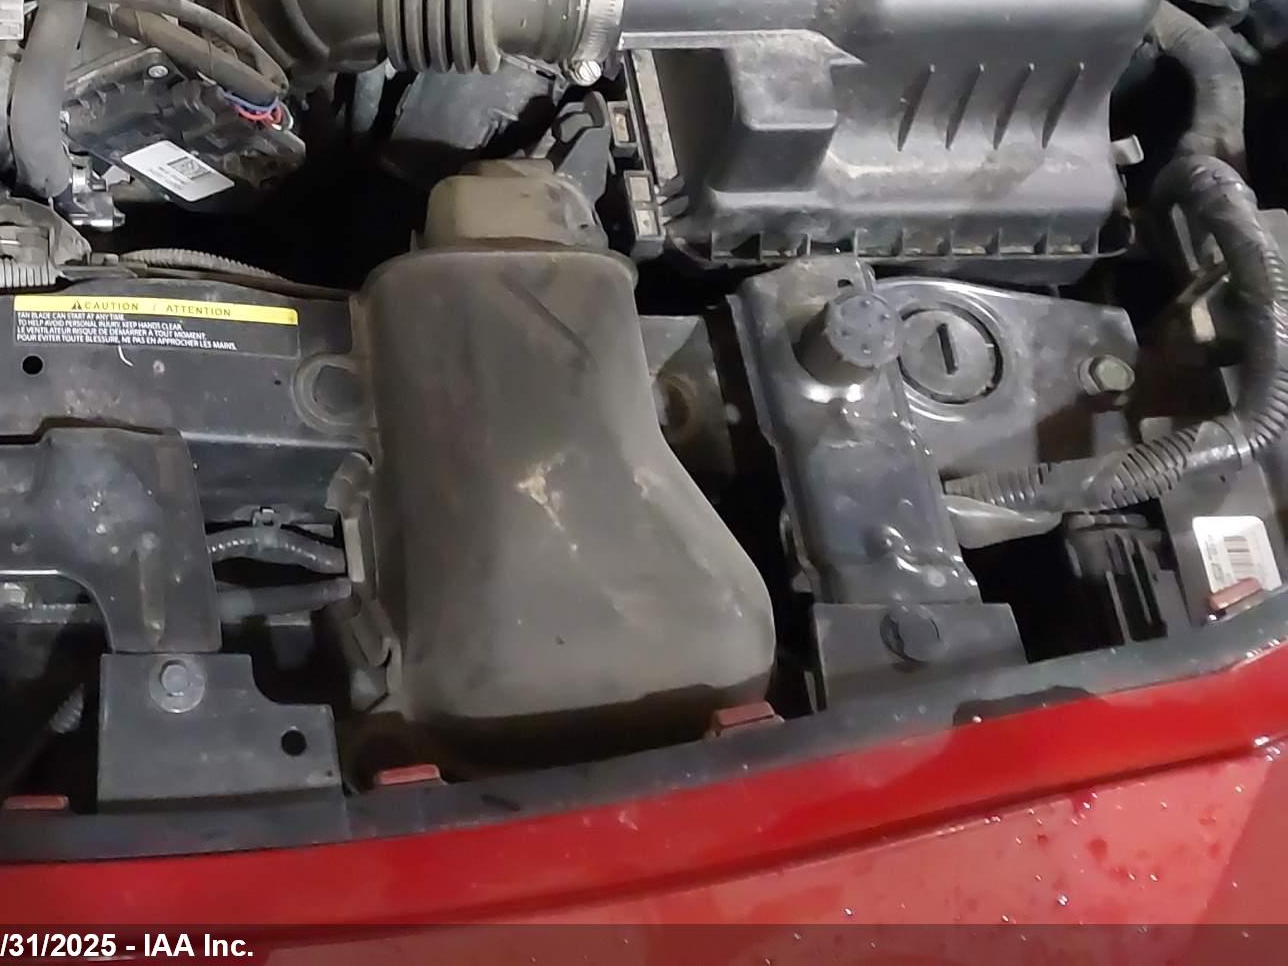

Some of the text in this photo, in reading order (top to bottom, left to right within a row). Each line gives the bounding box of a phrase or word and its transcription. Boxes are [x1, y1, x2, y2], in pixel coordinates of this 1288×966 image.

[84, 301, 139, 311] CAUTION
[166, 304, 231, 316] ATTENTION
[52, 312, 66, 320] CAN
[67, 312, 85, 320] START
[65, 320, 98, 328] PERSONAL
[138, 322, 160, 330] HANDS
[26, 327, 71, 335] VENTILATEUR
[154, 330, 172, 338] TOUT
[17, 334, 37, 342] POUR
[62, 334, 84, 342] TOUTE
[158, 338, 198, 347] APPROCHER
[200, 340, 211, 348] LES
